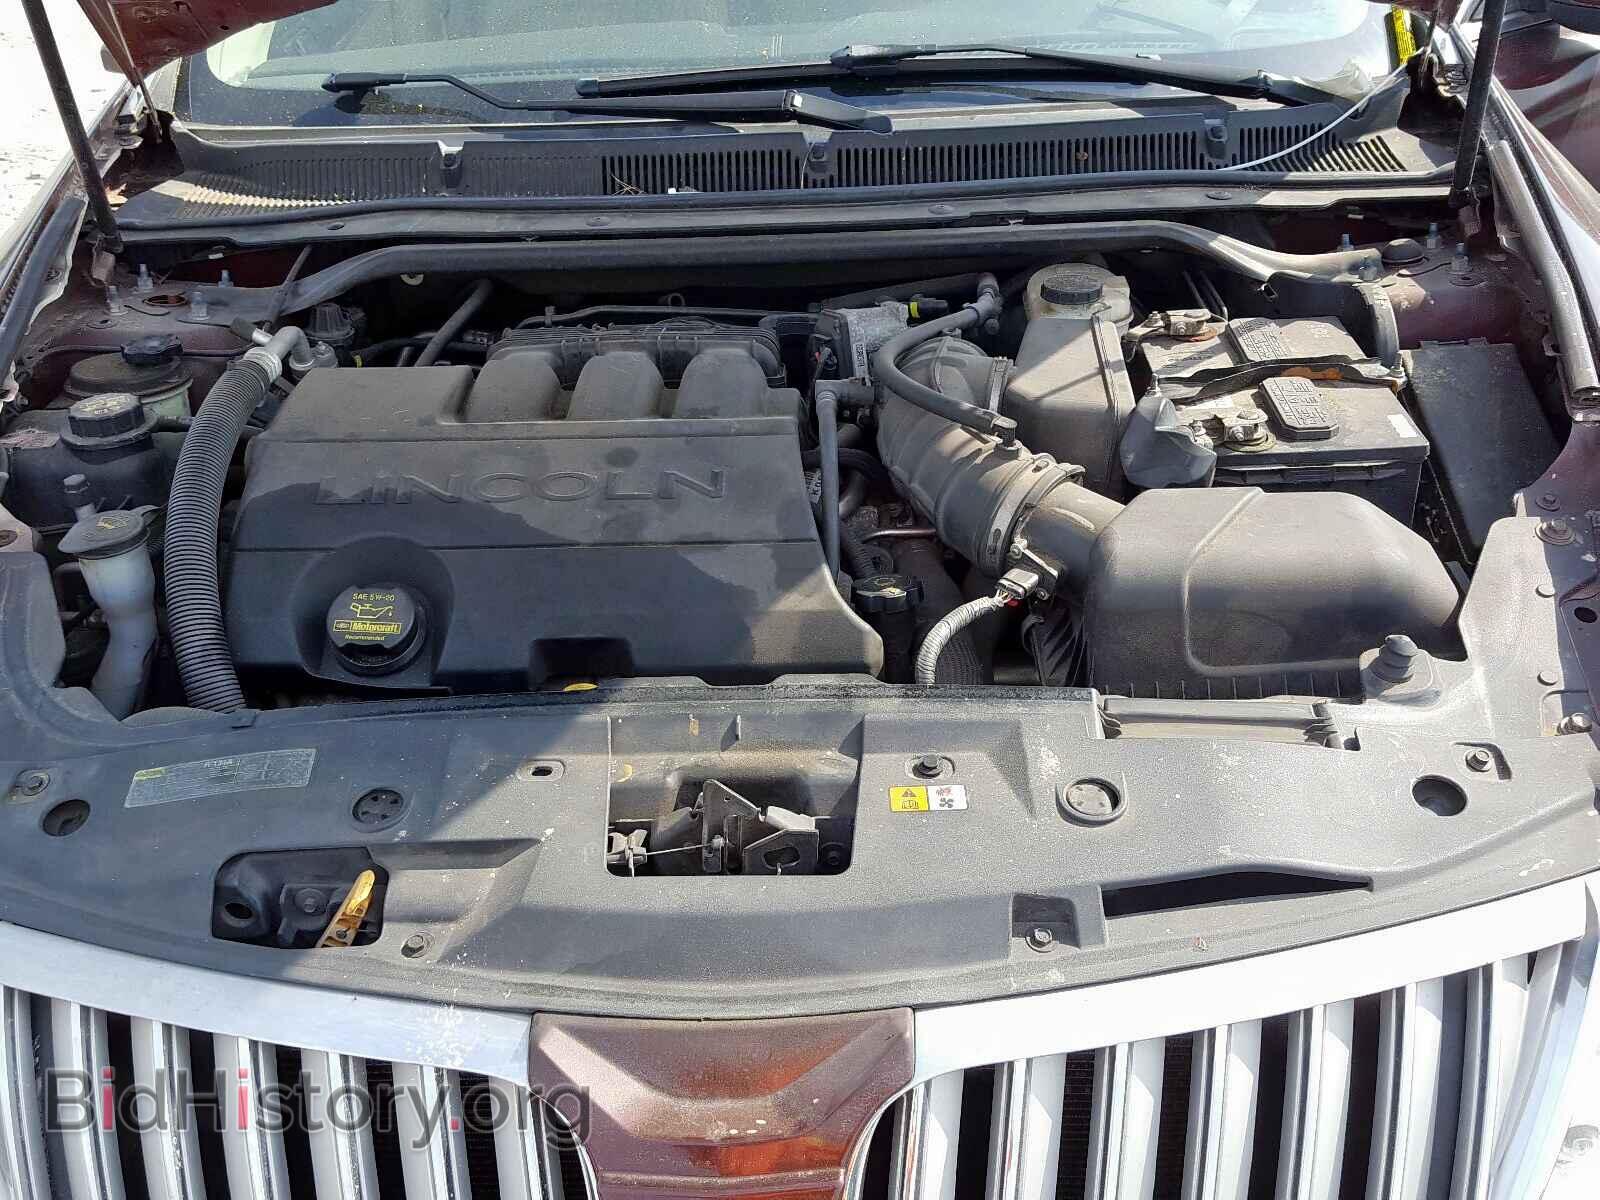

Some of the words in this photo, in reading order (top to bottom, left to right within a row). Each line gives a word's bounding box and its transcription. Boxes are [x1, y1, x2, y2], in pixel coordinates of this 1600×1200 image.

[313, 469, 727, 505] LINCOLN
[352, 592, 369, 601] SAE
[352, 622, 397, 633] Motorcraft
